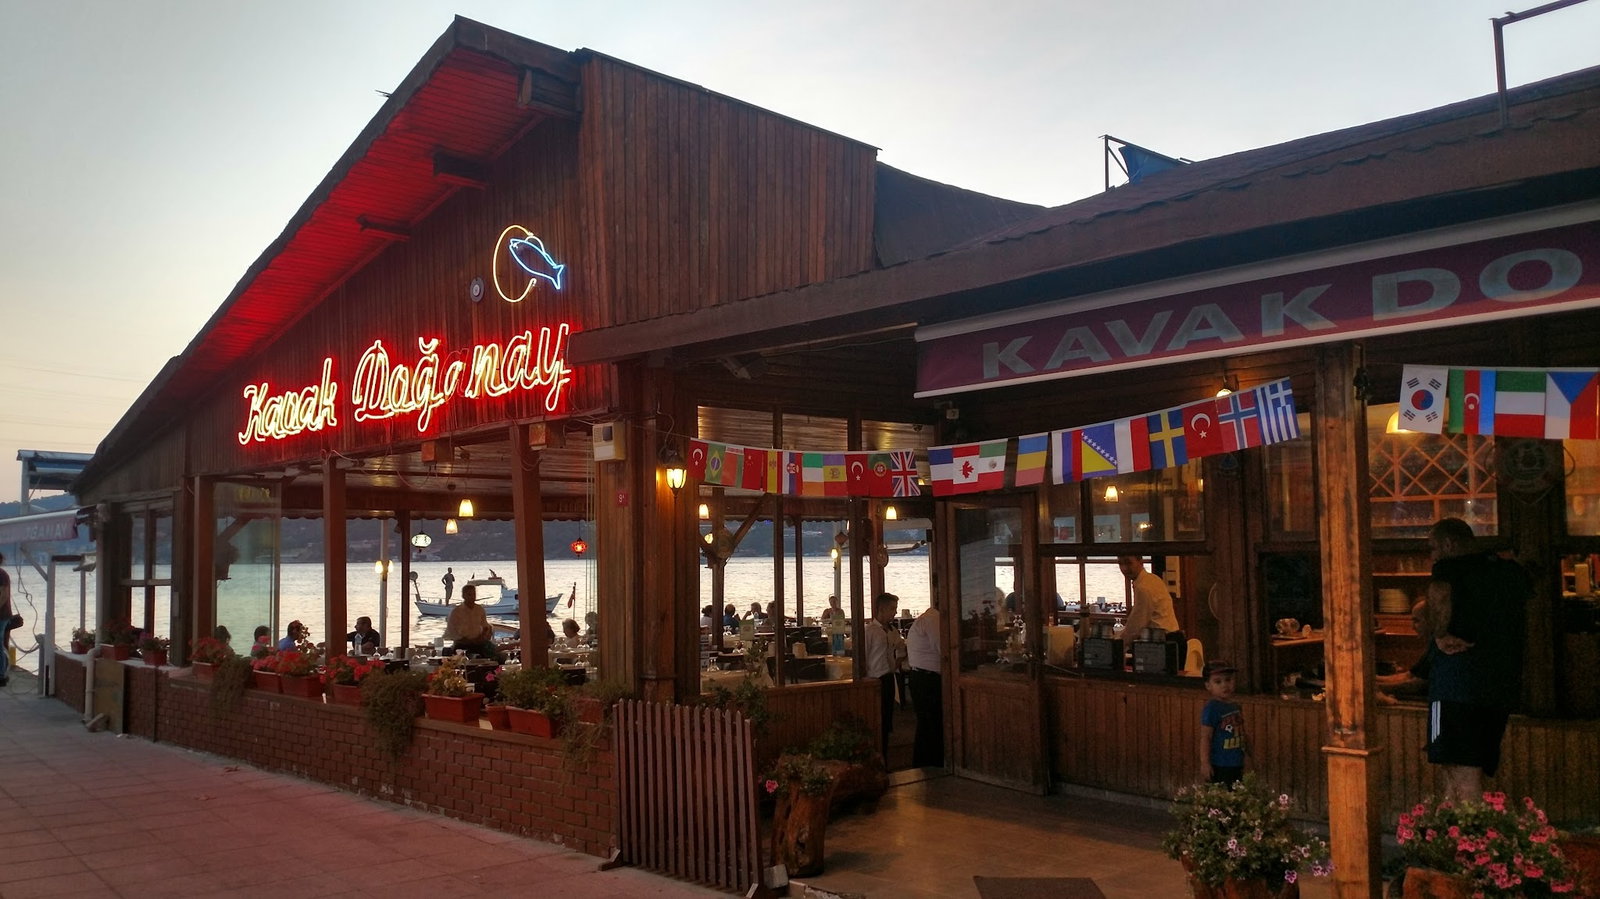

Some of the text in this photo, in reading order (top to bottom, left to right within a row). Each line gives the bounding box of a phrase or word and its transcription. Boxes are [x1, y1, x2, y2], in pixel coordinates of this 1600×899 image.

[238, 323, 572, 445] Kavak Doğanay
[982, 284, 1337, 380] KAVAK
